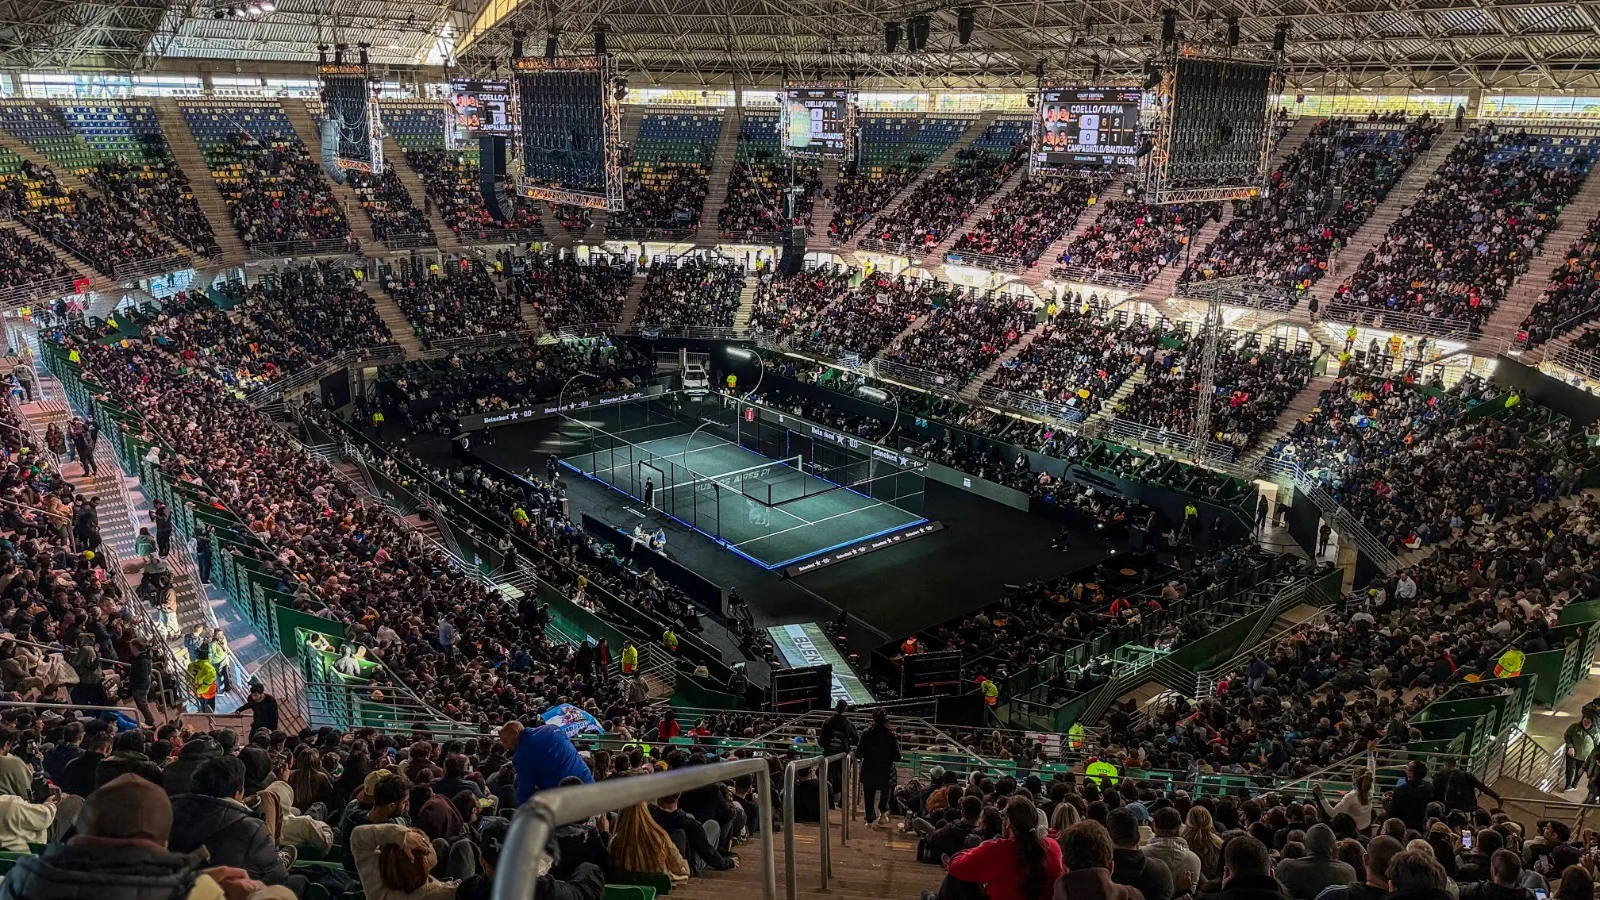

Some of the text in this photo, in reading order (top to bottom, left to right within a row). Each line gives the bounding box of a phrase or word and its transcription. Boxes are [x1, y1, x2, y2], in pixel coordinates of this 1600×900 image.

[1070, 105, 1123, 114] COELLO/TAPIA
[1087, 118, 1092, 126] 0
[1114, 118, 1119, 127] 2
[1113, 134, 1117, 142] 1
[1067, 144, 1134, 154] CAMPAGNOLO/BAUTISTA
[793, 637, 825, 666] BUEN
